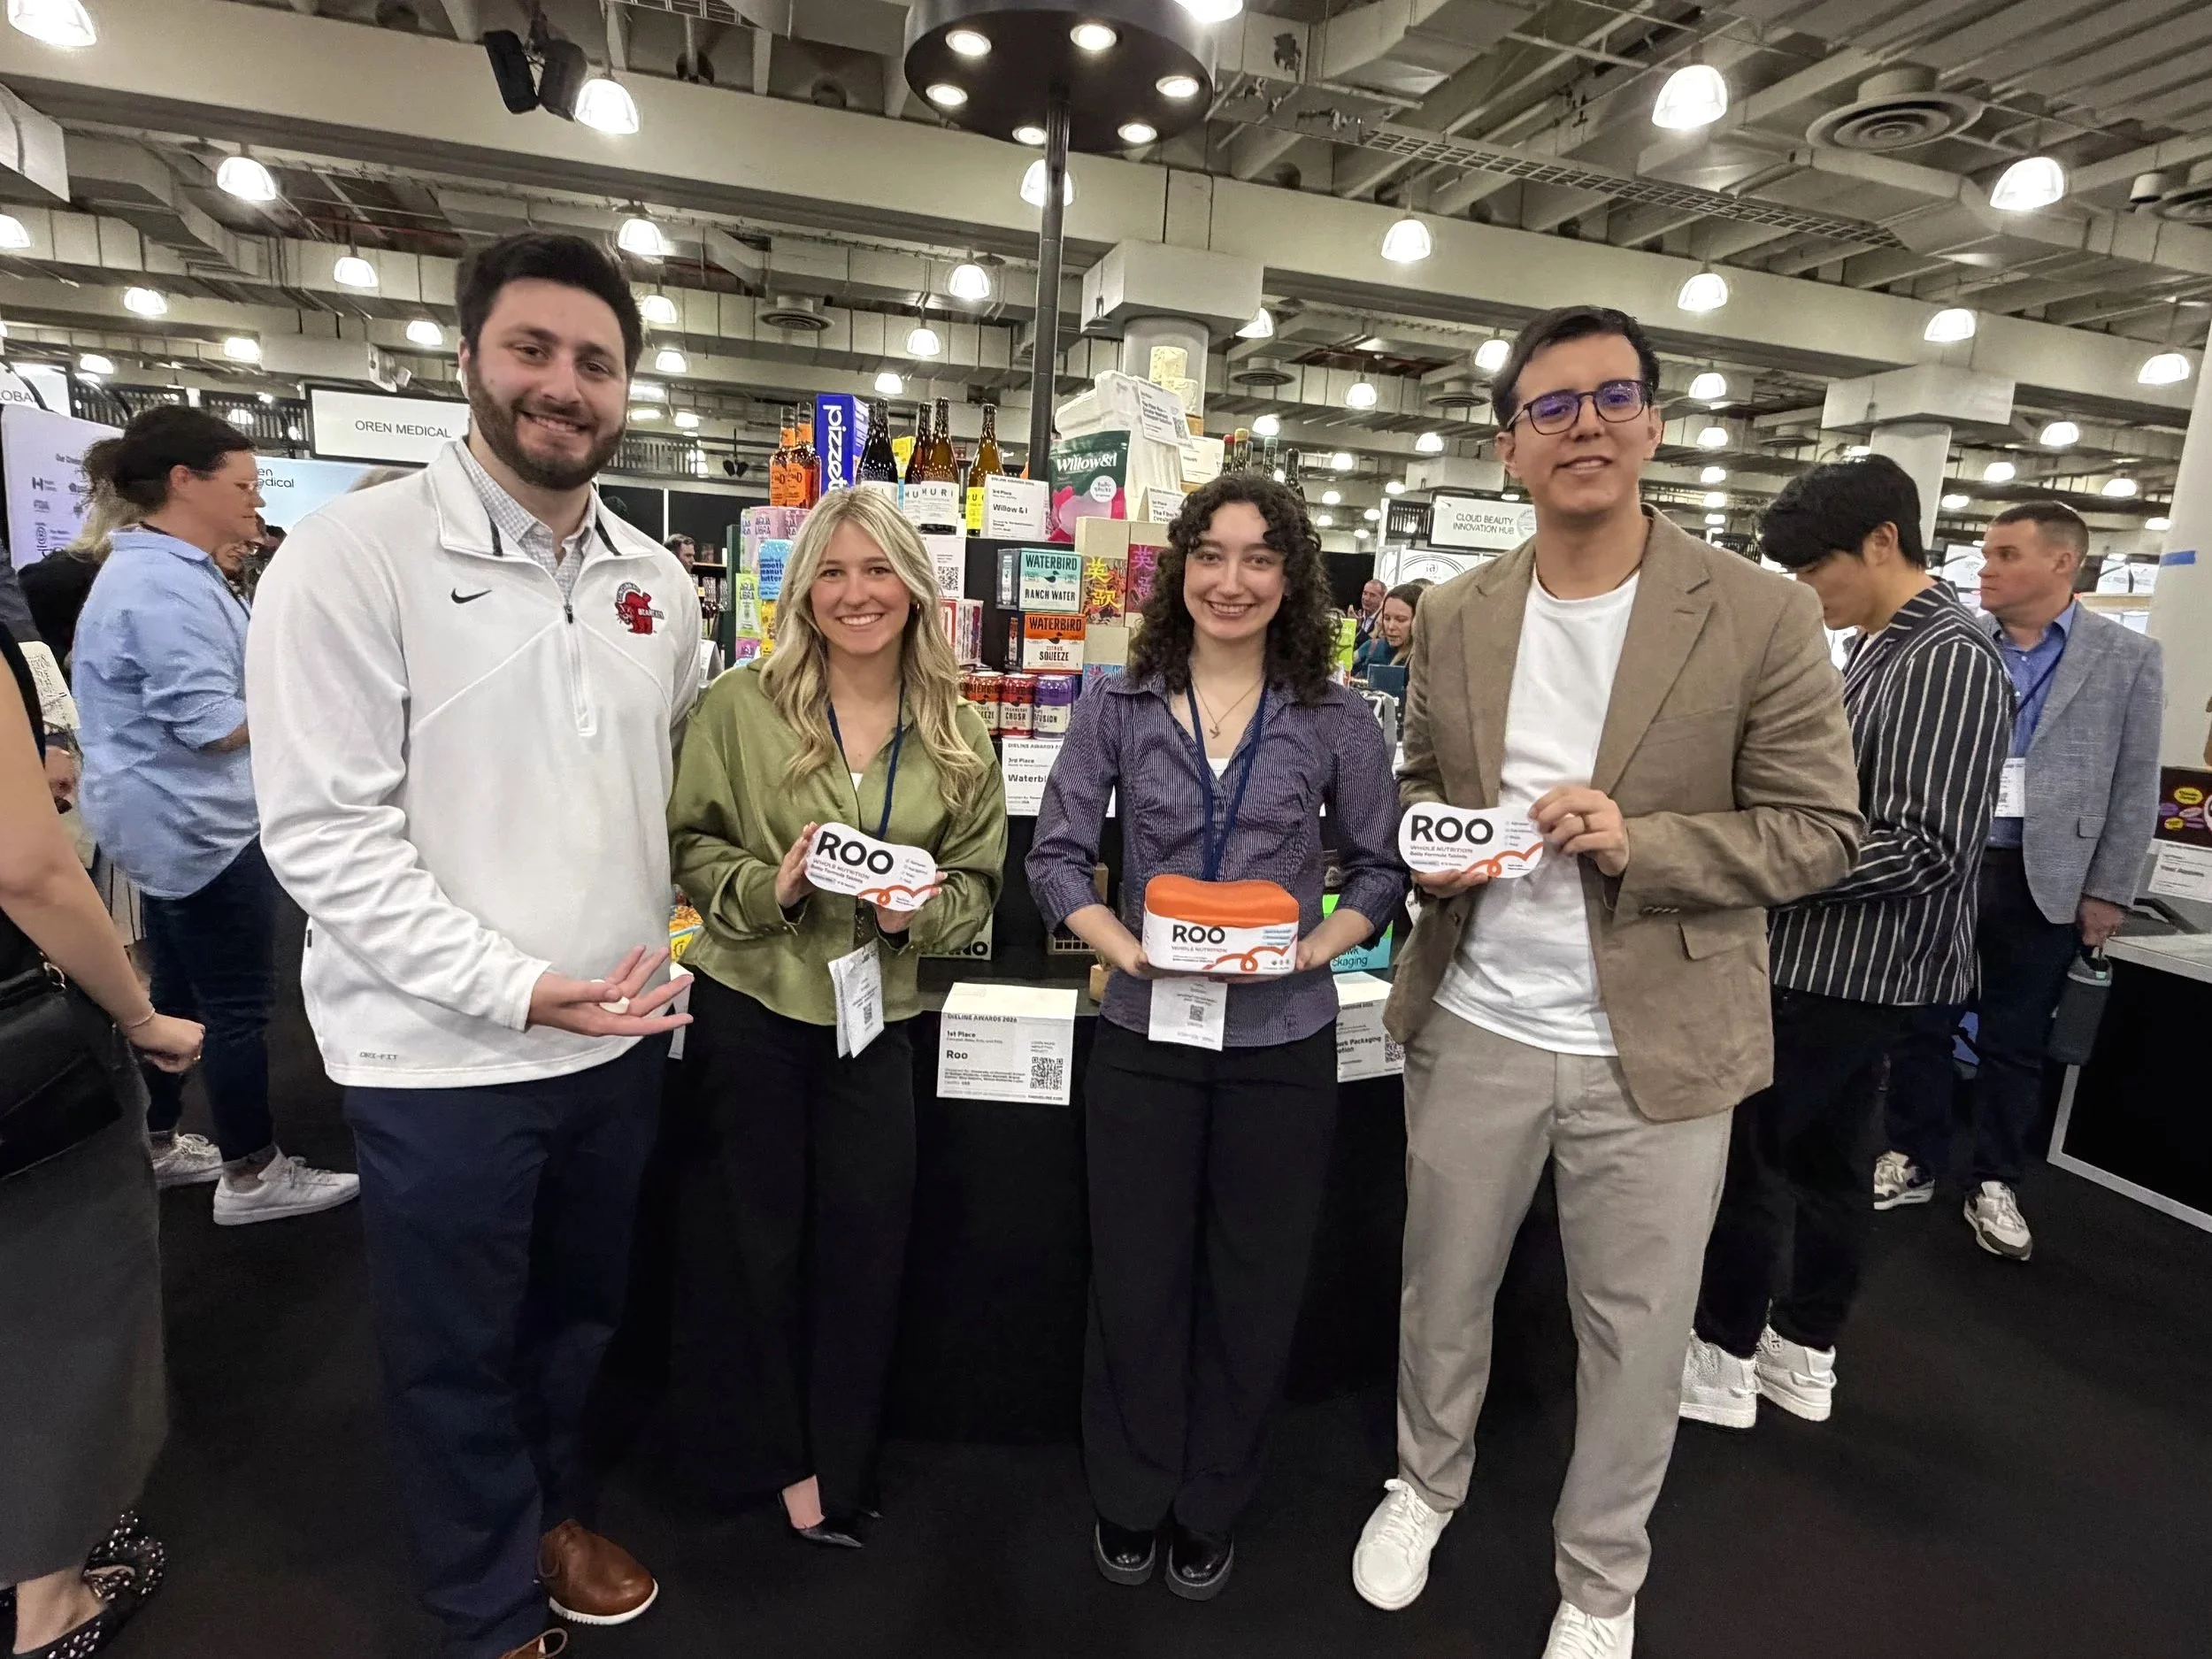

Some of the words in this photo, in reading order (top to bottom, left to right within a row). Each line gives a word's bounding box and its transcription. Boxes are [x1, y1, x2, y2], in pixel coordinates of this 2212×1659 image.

[355, 419, 392, 434] OREN
[396, 424, 452, 439] MEDICAL
[993, 503, 1018, 513] Willow
[1455, 512, 1482, 523] CLOUD
[1484, 515, 1514, 526] BEAUTY
[1453, 522, 1498, 534] INNOVATION
[1498, 526, 1515, 535] HUB
[1025, 554, 1078, 571] WATERBIRD
[1025, 588, 1049, 600] RANCH
[1052, 590, 1076, 602] WATER
[1029, 617, 1082, 632] WATERBIRD
[1039, 651, 1069, 662] SQUEEZE
[1410, 814, 1494, 845] ROO
[816, 830, 895, 875] ROO
[1171, 924, 1225, 945] ROO
[946, 1049, 968, 1060] Roo
